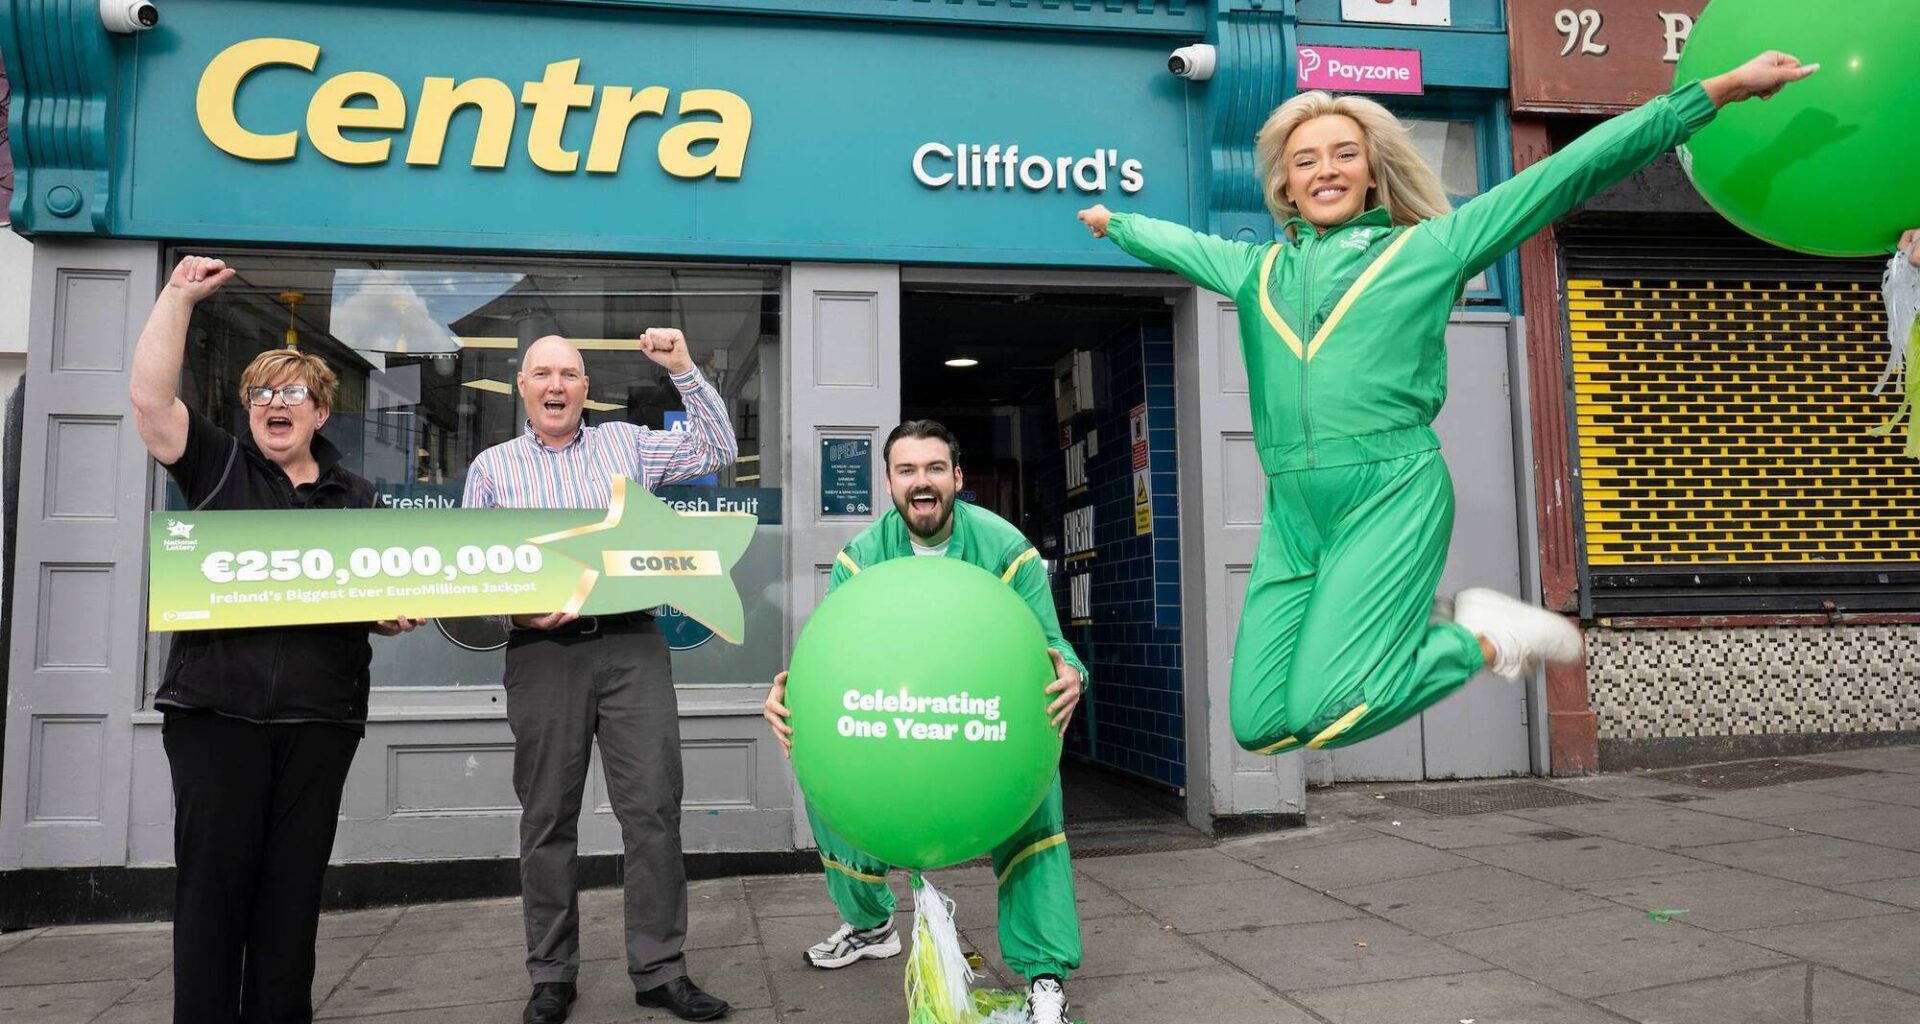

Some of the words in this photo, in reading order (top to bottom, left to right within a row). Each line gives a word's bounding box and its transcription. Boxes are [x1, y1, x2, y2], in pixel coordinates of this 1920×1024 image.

[1554, 9, 1608, 56] 92
[1328, 60, 1411, 82] Payzone
[196, 37, 752, 179] Centra
[912, 141, 1144, 194] Clifford's
[717, 497, 759, 513] Fruit
[163, 538, 198, 546] National
[201, 544, 544, 586] €250,000,000
[630, 556, 697, 571] CORK
[210, 590, 282, 604] Ireland's
[286, 587, 346, 604] Biggest
[348, 586, 383, 598] Ever
[386, 582, 479, 597] EuroMillions
[481, 581, 537, 595] Jackpot
[842, 687, 1001, 721] Celebrating
[837, 715, 888, 738] One
[893, 717, 959, 741] Year
[964, 719, 1007, 742] On!
